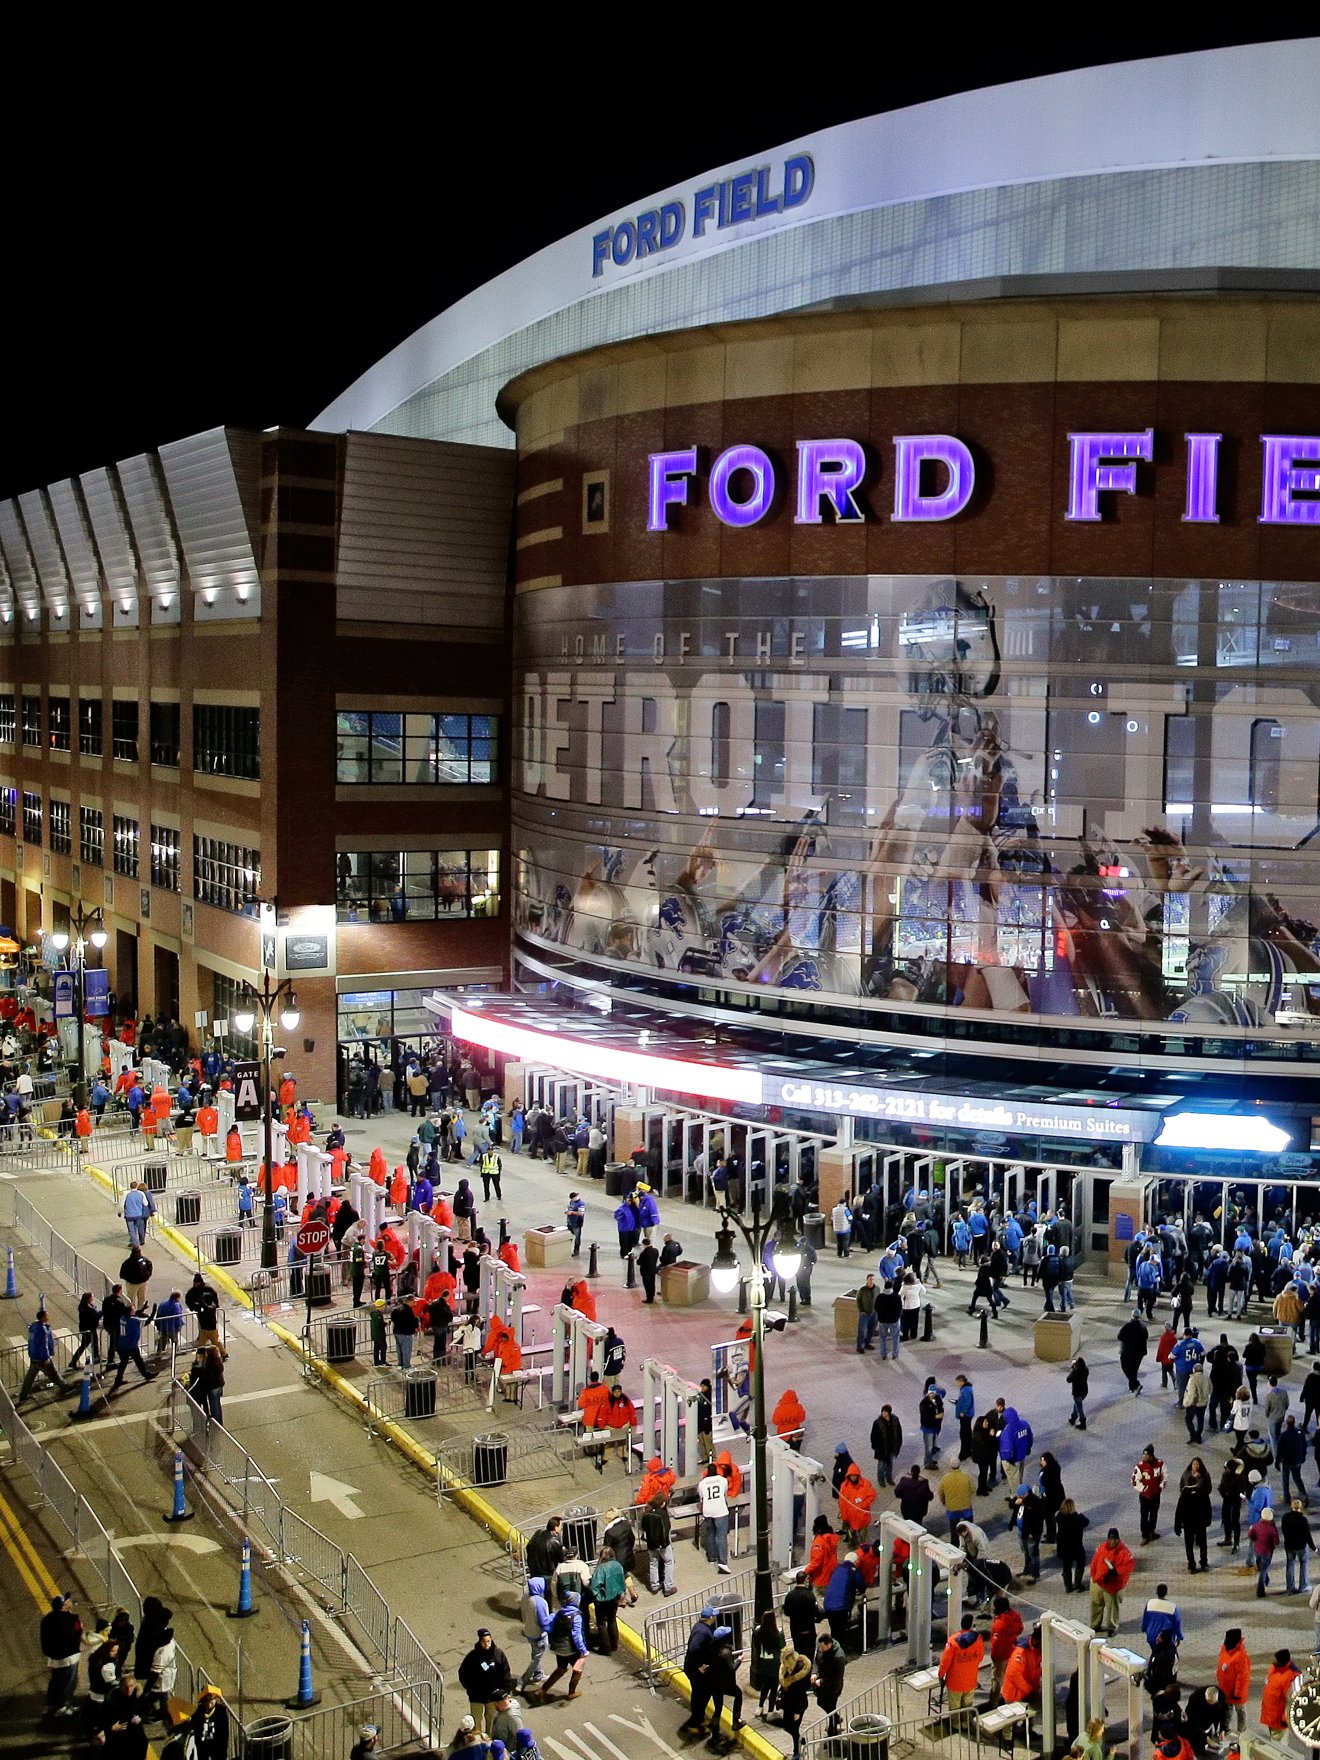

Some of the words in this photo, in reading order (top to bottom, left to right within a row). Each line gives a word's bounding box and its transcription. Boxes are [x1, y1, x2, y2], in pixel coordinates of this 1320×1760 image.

[592, 199, 687, 277] FORD
[692, 150, 817, 239] FIELD
[647, 434, 976, 532] FORD
[560, 634, 626, 665] HOME
[653, 632, 691, 665] OF
[725, 631, 806, 666] THE
[236, 1070, 259, 1079] GATE
[237, 1080, 259, 1107] A
[781, 1083, 812, 1104] Call
[929, 1100, 955, 1121] for
[1016, 1113, 1082, 1131] Premium
[1086, 1117, 1131, 1134] Suites
[298, 1230, 328, 1246] STOP
[374, 1255, 387, 1266] 87
[1185, 1349, 1197, 1362] 54
[707, 1485, 720, 1500] 12
[1309, 1687, 1316, 1697] 11
[1297, 1697, 1308, 1706] 10
[1296, 1708, 1303, 1717] 9
[1299, 1720, 1306, 1729] 8
[1309, 1728, 1314, 1737] 7
